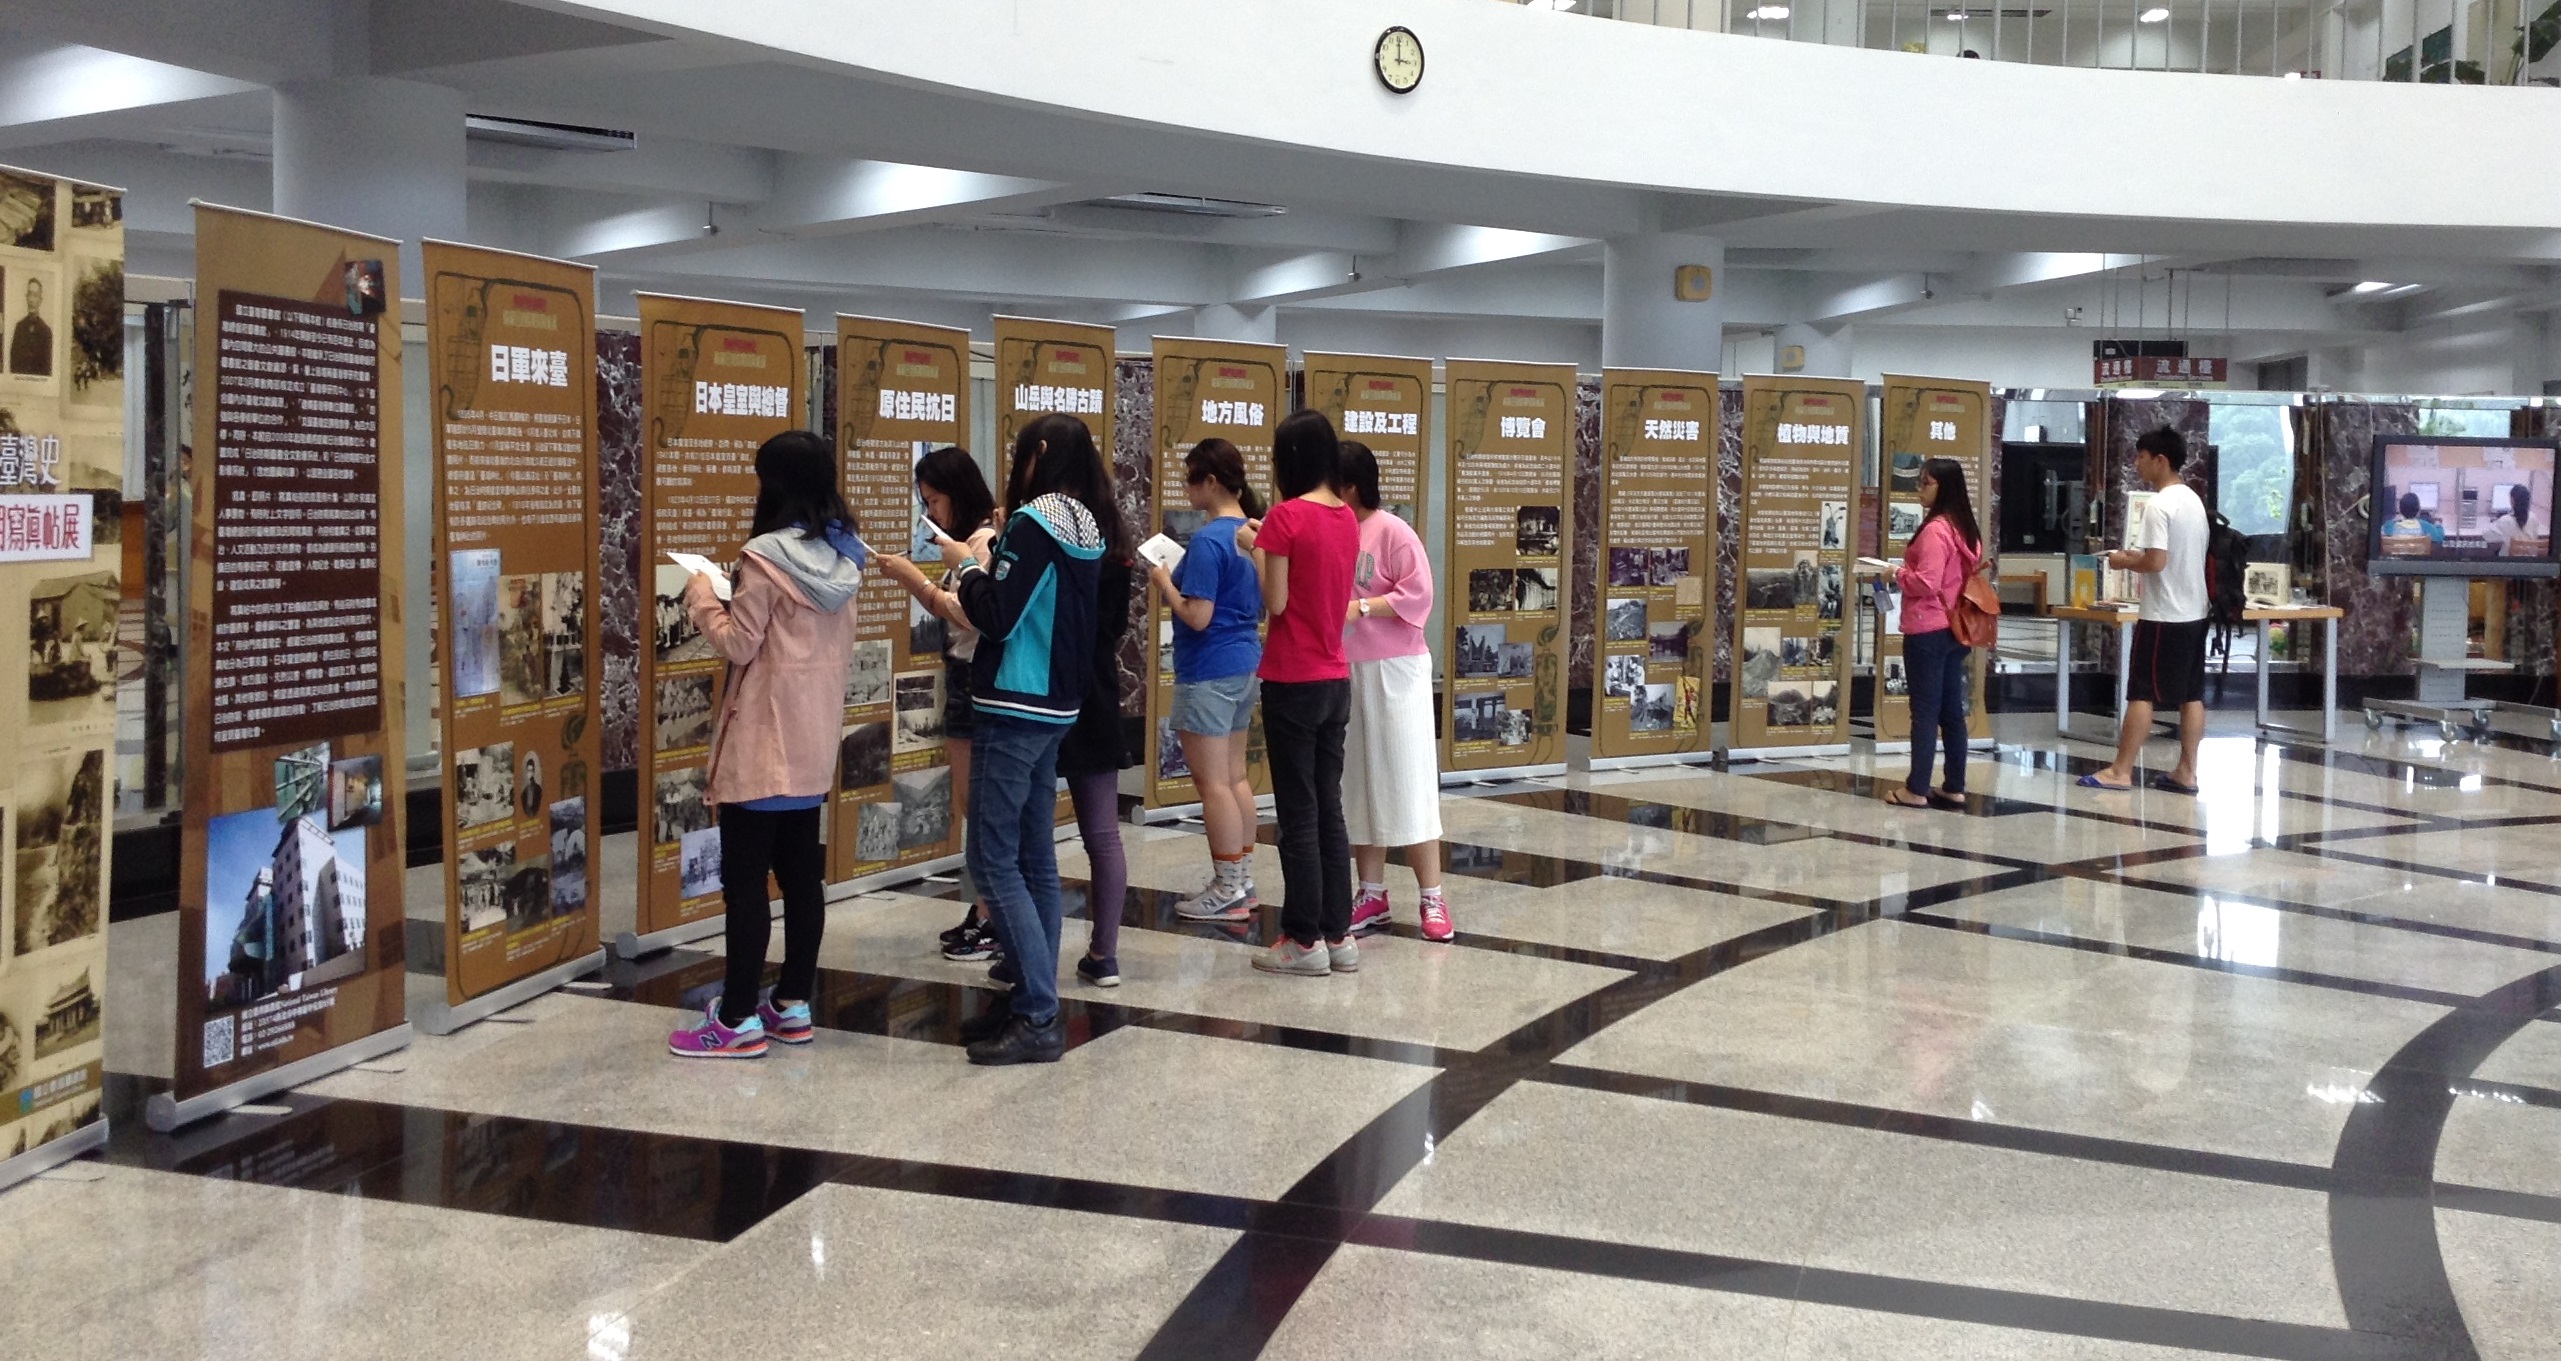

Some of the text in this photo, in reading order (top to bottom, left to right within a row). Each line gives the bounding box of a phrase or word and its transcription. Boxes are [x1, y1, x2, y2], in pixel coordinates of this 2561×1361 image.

[491, 344, 568, 387] 日軍來臺
[695, 381, 789, 418] 日本皇室與總督
[879, 389, 955, 422] 原住民抗日
[1015, 383, 1104, 415] 山岳與名勝古蹟
[1201, 399, 1264, 426] 地方風俗
[1344, 410, 1418, 435] 建設及工程
[1501, 416, 1546, 438] 博覽會
[1644, 419, 1699, 441] 天然災害
[1778, 422, 1849, 445] 植物與地質
[1930, 420, 1956, 440] 其他
[699, 1030, 722, 1051] N
